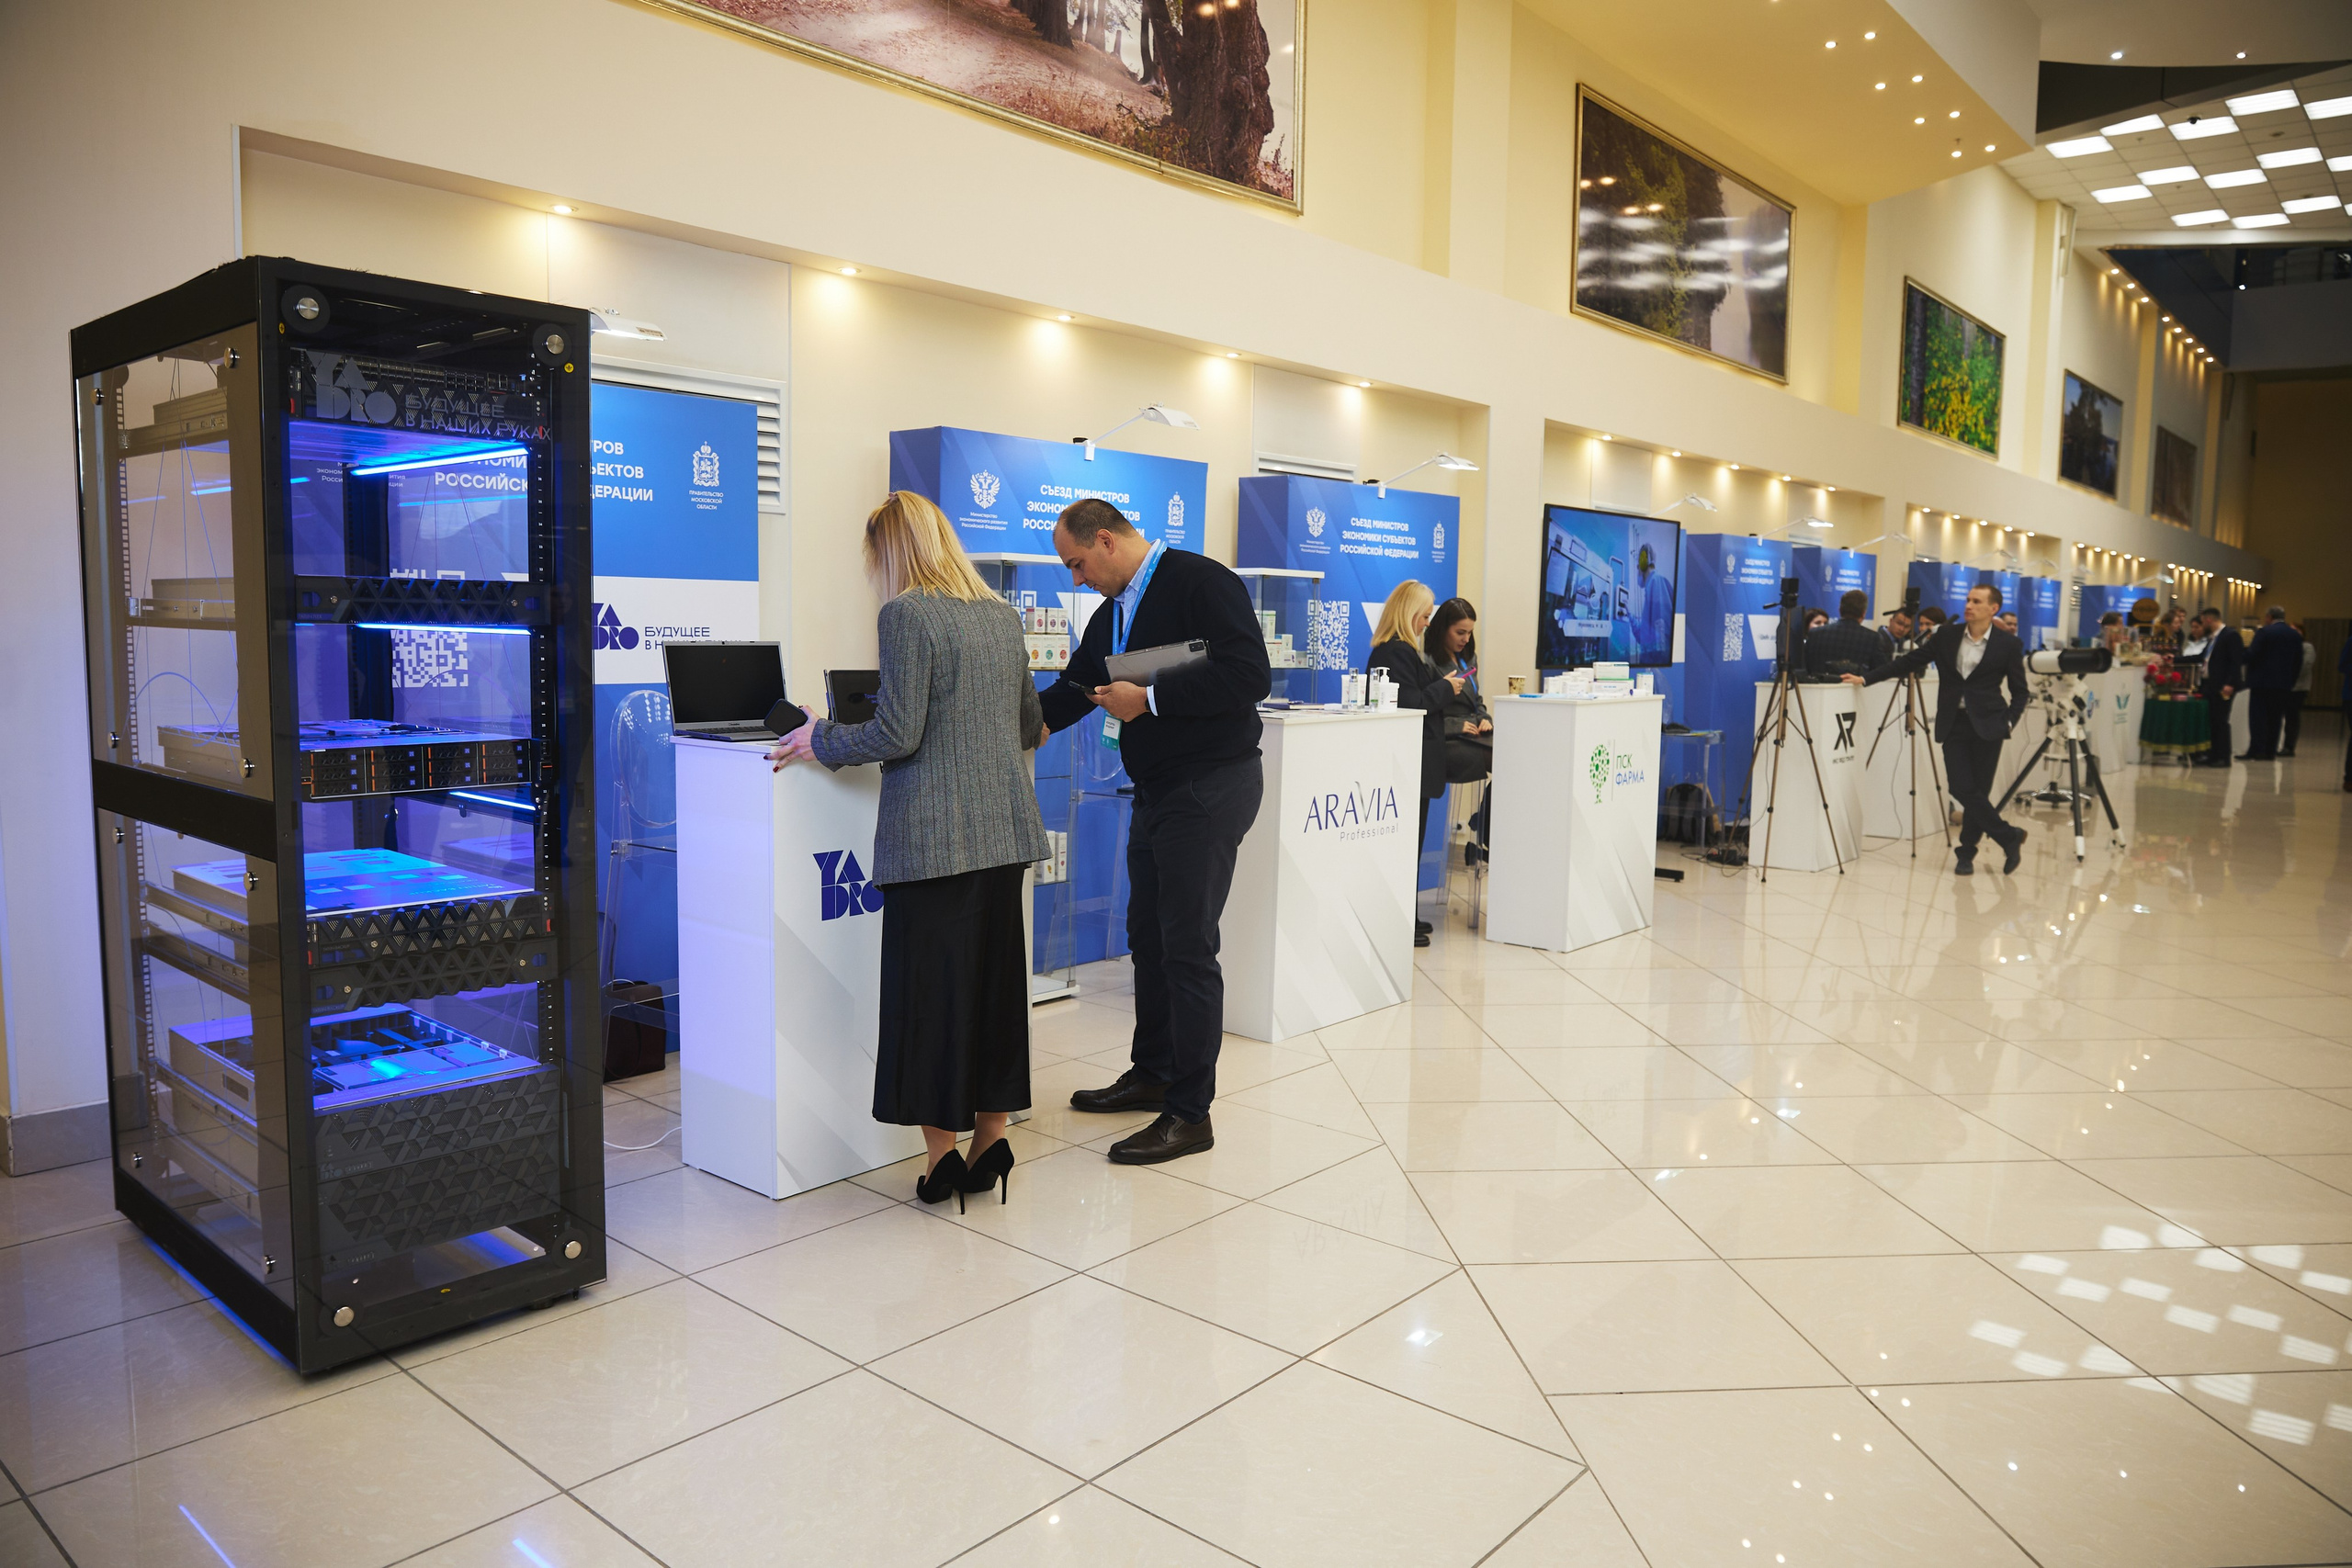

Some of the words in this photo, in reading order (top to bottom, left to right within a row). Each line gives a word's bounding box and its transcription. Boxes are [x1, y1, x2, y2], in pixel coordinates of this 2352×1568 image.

[405, 394, 505, 418] БУДУЩЕЕ
[405, 416, 413, 427] В
[420, 418, 492, 435] НАШИХ
[496, 426, 551, 441] РУКАХ
[591, 440, 624, 455] РОВ
[689, 490, 724, 498] ПРАВИТЕЛЬСТВО
[1040, 484, 1073, 500] СЪЕЗД
[1074, 488, 1130, 504] МИНИСТРОВ
[1351, 517, 1372, 529] СЪЕЗД
[1373, 520, 1408, 532] МИНИСТРОВ
[1342, 530, 1382, 543] ЭКОНОМИКИ
[1382, 533, 1416, 546] СУБЪЕКТОВ
[1340, 543, 1383, 557] РОССИЙСКОЙ
[1384, 547, 1419, 559] ФЕДЕРАЦИИ
[645, 626, 710, 638] БУДУЩЕЕ
[645, 639, 651, 650] В
[1616, 753, 1633, 770] ПСК
[1615, 770, 1645, 786] ФАРМА
[1304, 781, 1398, 833] ARAVIA
[1340, 823, 1399, 842] Professional
